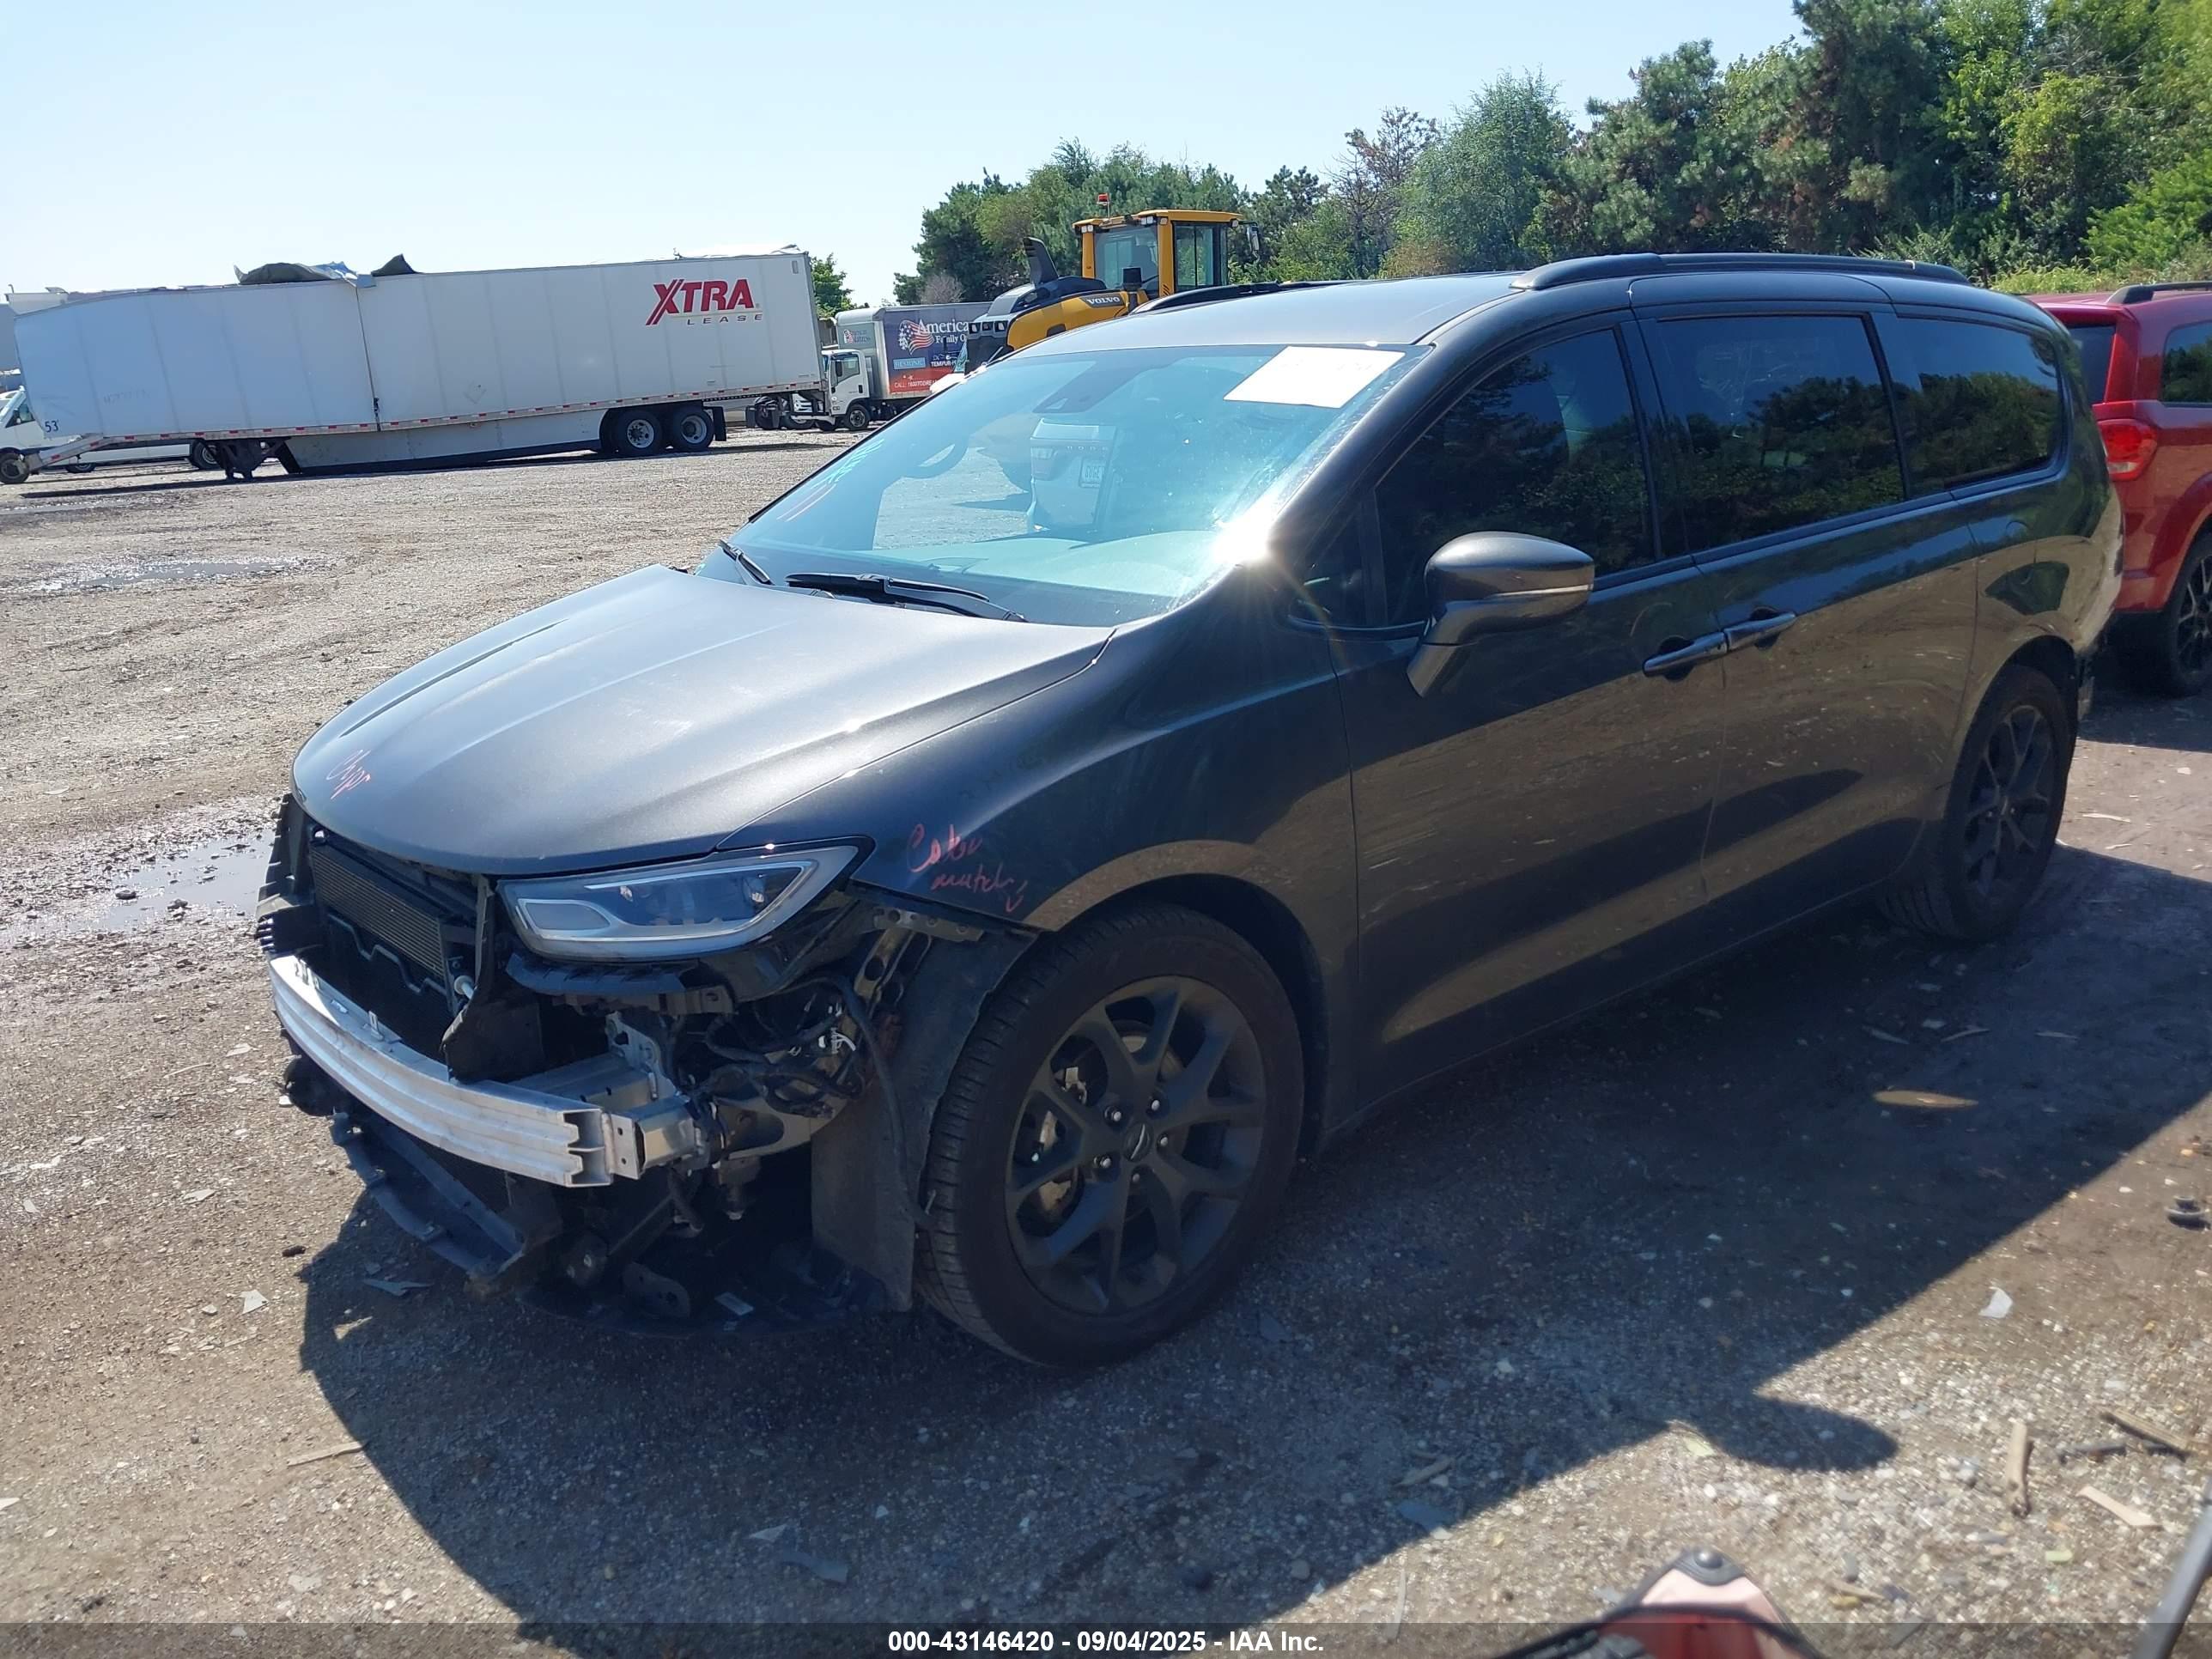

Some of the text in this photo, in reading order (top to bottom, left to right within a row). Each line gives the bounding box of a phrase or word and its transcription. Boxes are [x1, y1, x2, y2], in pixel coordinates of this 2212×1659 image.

[646, 279, 754, 325] XTRA
[1086, 296, 1121, 305] VOLVO
[687, 314, 763, 325] LEASE
